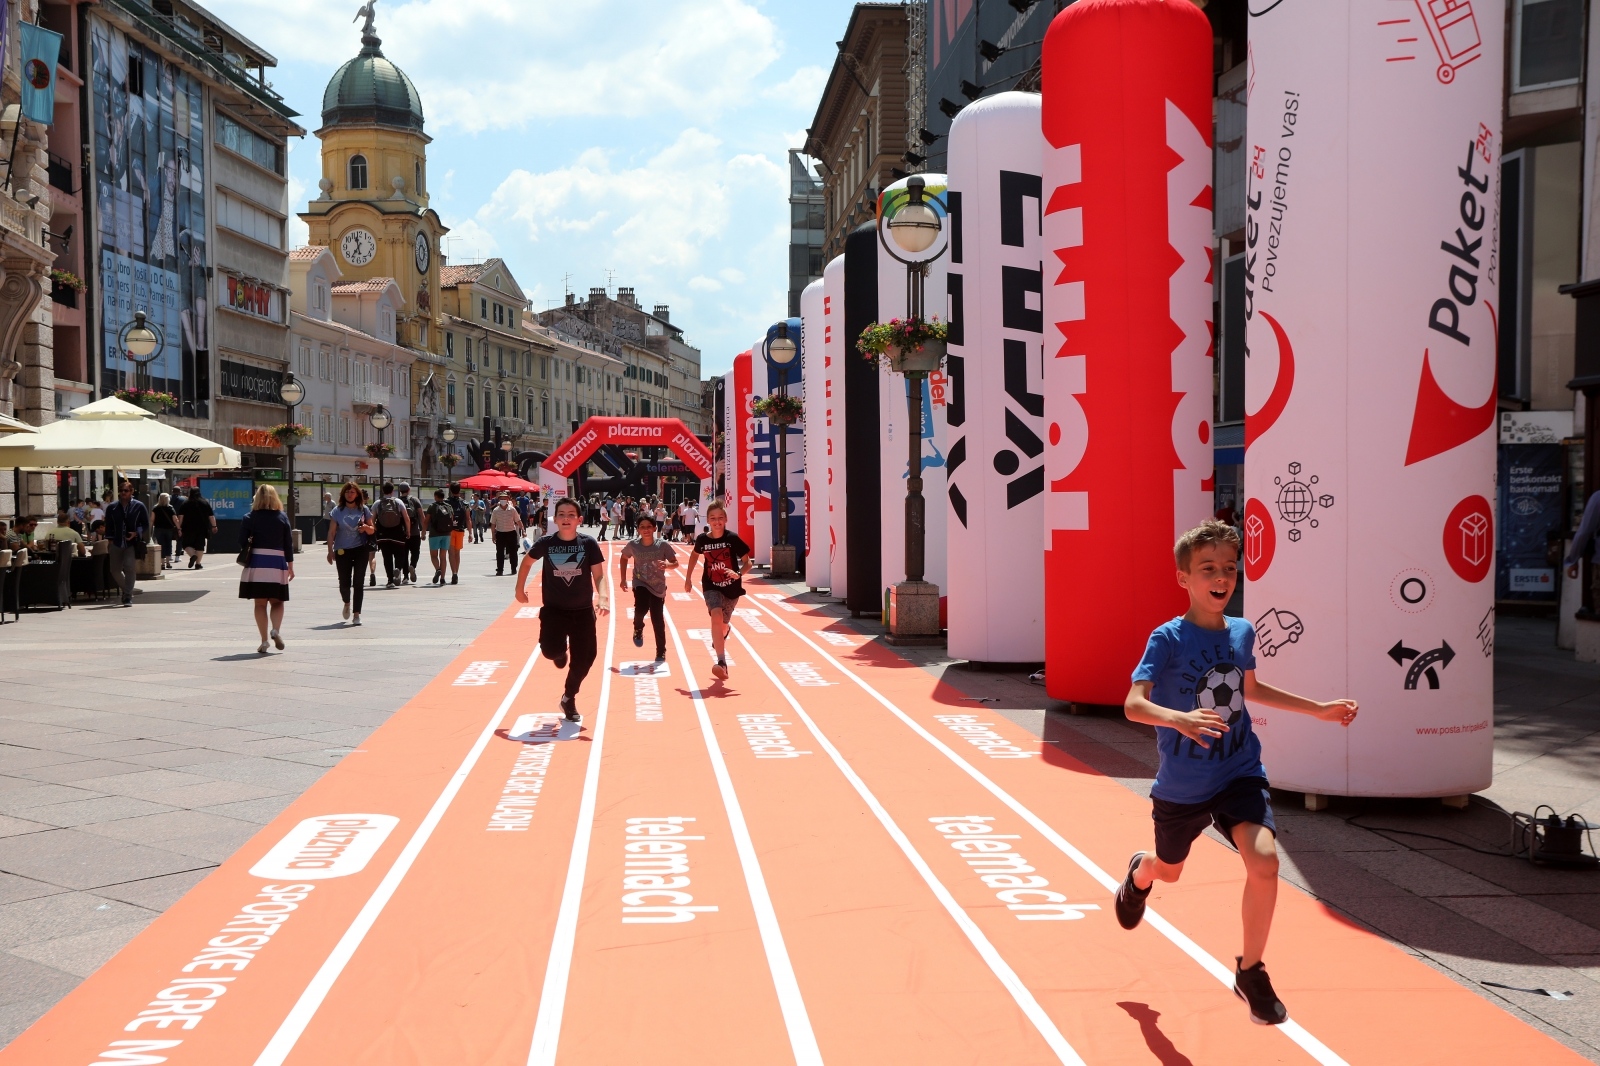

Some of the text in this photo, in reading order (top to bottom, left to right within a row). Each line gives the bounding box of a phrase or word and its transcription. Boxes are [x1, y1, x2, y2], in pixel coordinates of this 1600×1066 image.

[1262, 90, 1300, 292] Povezujemo vas!
[107, 257, 131, 276] Dbro
[1428, 140, 1489, 347] Paket
[107, 294, 125, 310] nain
[552, 429, 598, 473] plazma
[608, 424, 662, 438] plazma
[646, 463, 691, 473] telemac
[711, 563, 726, 571] AND
[1180, 645, 1235, 696] SOCCER
[736, 713, 813, 759] telemach
[932, 714, 1042, 759] telemach
[284, 819, 378, 870] plazma
[928, 815, 1101, 922] telemach
[622, 816, 719, 924] telemach
[182, 884, 316, 972] SPORTSKE
[124, 977, 237, 1032] IGRE
